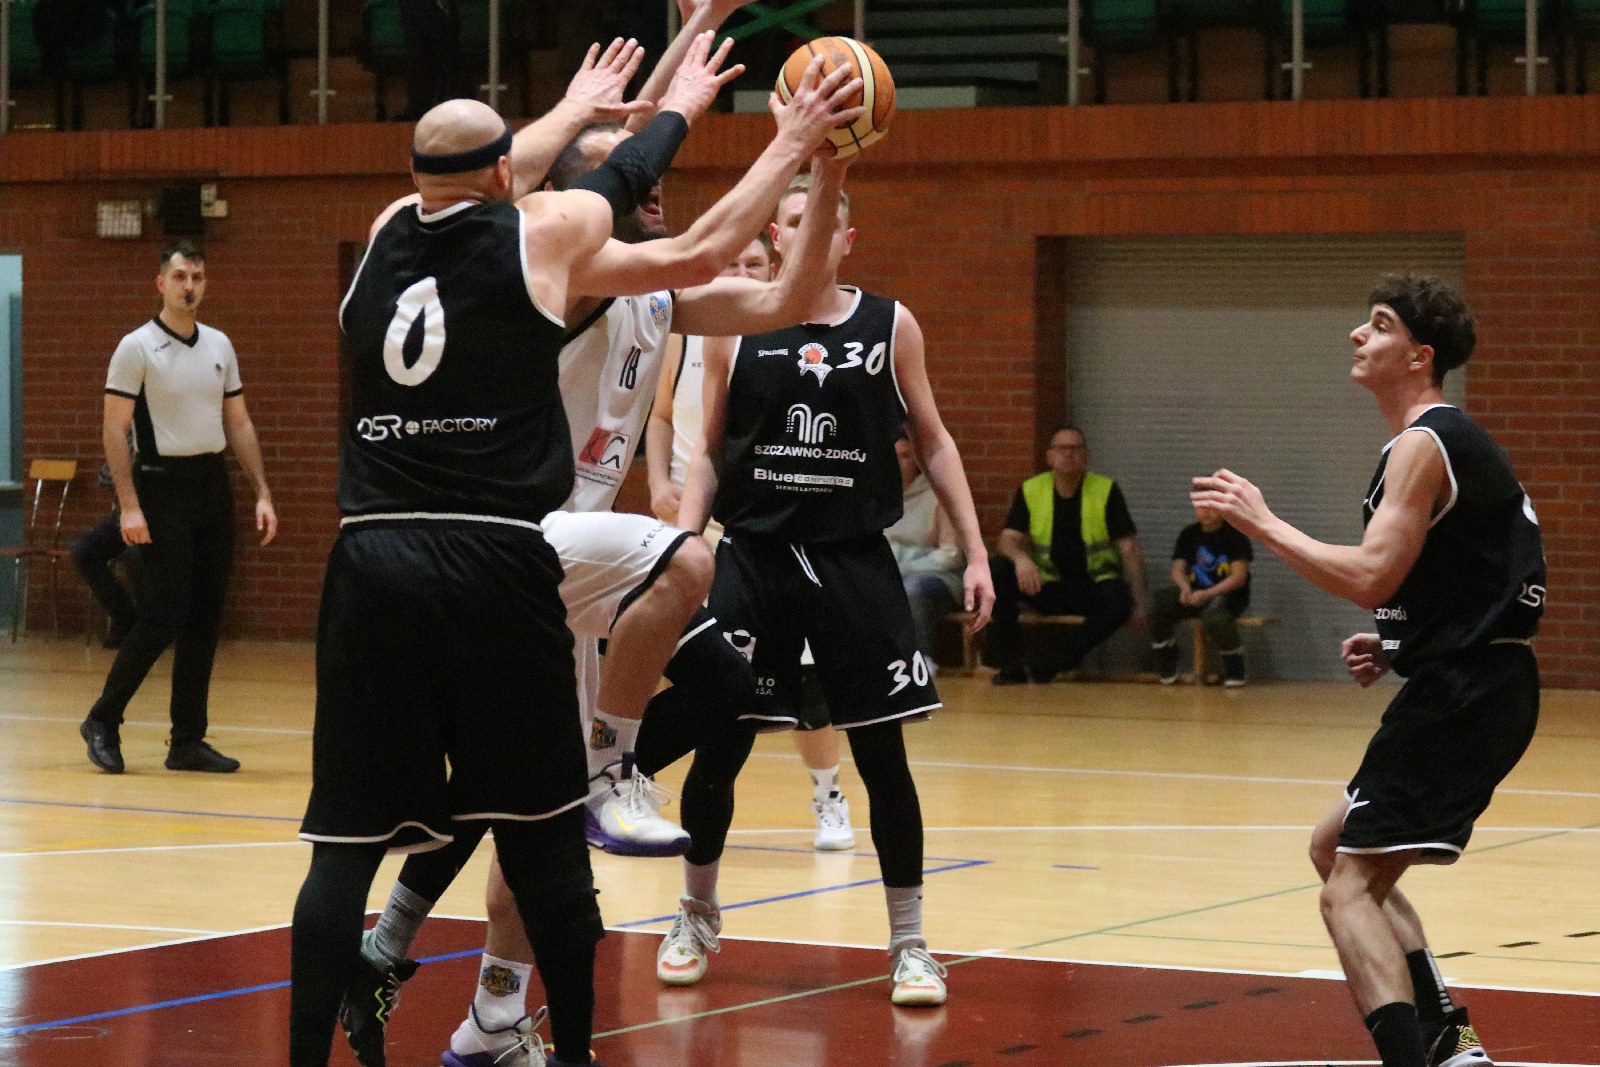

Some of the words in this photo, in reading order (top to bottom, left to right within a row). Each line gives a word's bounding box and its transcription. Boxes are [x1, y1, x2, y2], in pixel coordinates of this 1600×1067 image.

[383, 276, 446, 386] 0
[619, 345, 641, 390] 18
[836, 341, 887, 376] 30
[422, 417, 498, 434] FACTORY
[754, 445, 867, 463] SZCZAWNO-ZDRÓJ
[887, 650, 929, 697] 30
